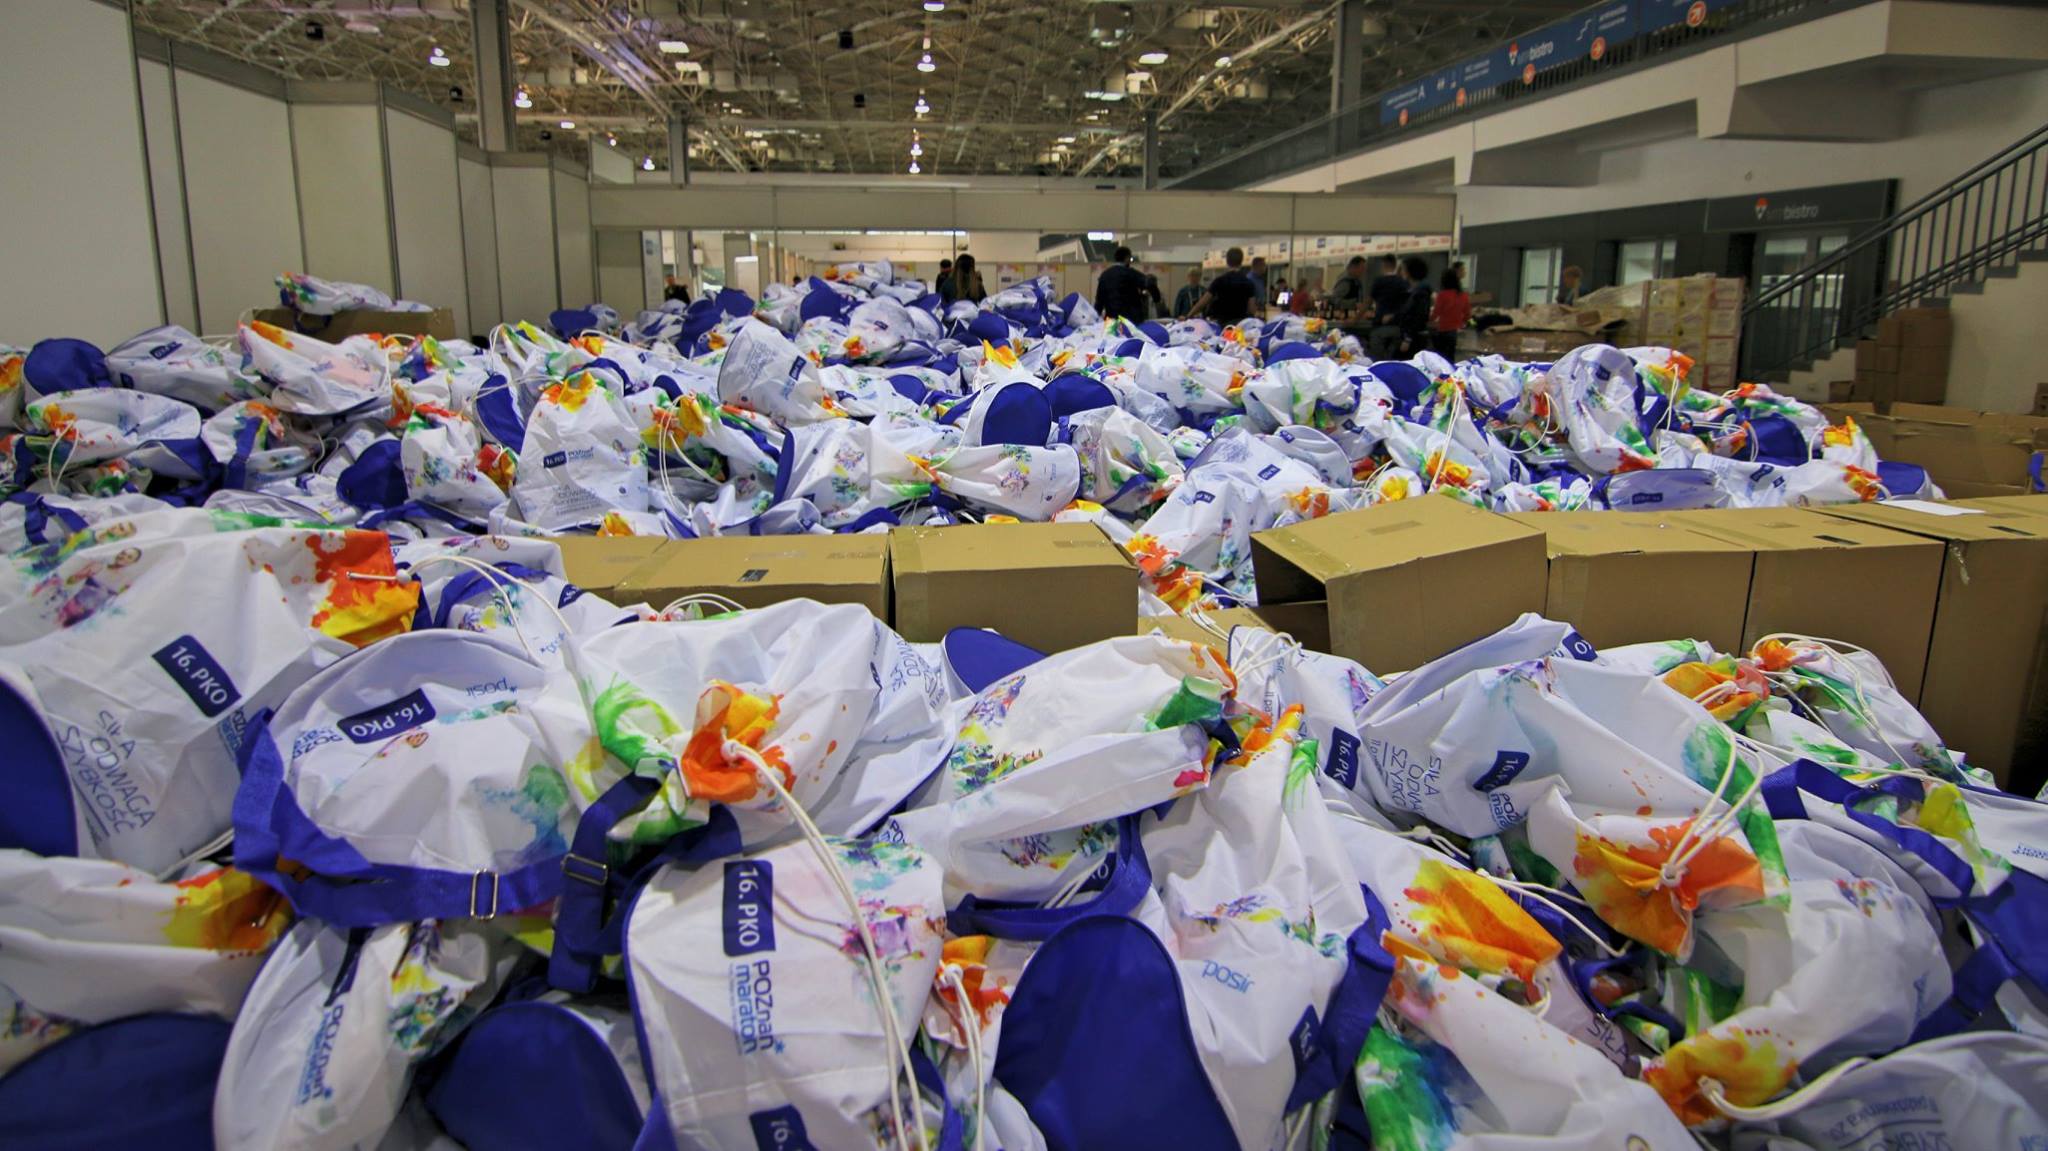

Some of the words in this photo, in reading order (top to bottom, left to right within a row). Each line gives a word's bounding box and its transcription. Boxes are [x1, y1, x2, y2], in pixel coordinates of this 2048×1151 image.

[171, 646, 198, 673] 16.
[190, 668, 228, 705] PKO
[351, 719, 396, 738] PKO
[395, 701, 424, 723] 16.
[738, 867, 759, 899] 16.
[738, 903, 760, 947] PKO
[1202, 960, 1255, 994] posir
[735, 964, 759, 1056] maraton
[770, 1118, 788, 1151] 16.
